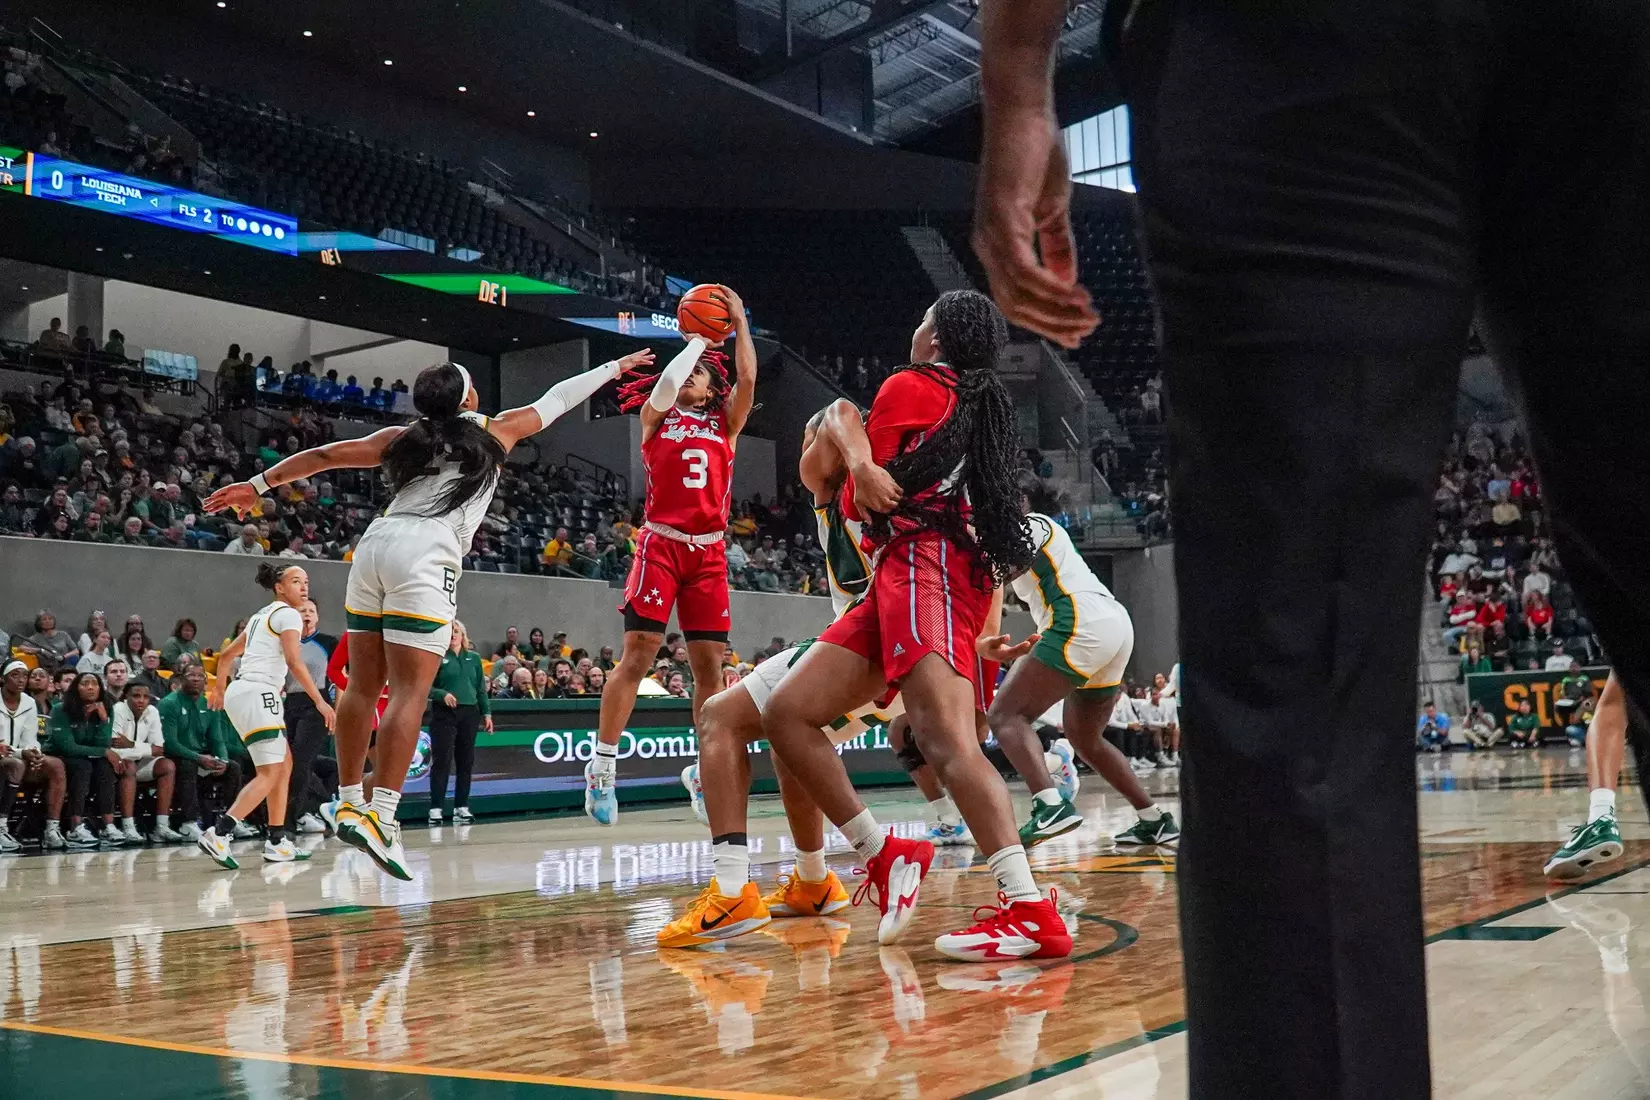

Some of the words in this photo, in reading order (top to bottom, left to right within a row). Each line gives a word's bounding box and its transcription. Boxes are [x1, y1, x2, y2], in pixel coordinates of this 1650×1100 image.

[52, 170, 63, 189] 0
[81, 176, 142, 200] LOUISIANA
[96, 191, 126, 206] TECH
[179, 204, 197, 217] FLS
[203, 208, 212, 224] 2
[221, 214, 234, 227] TO
[681, 448, 708, 489] 3
[533, 731, 599, 763] Old
